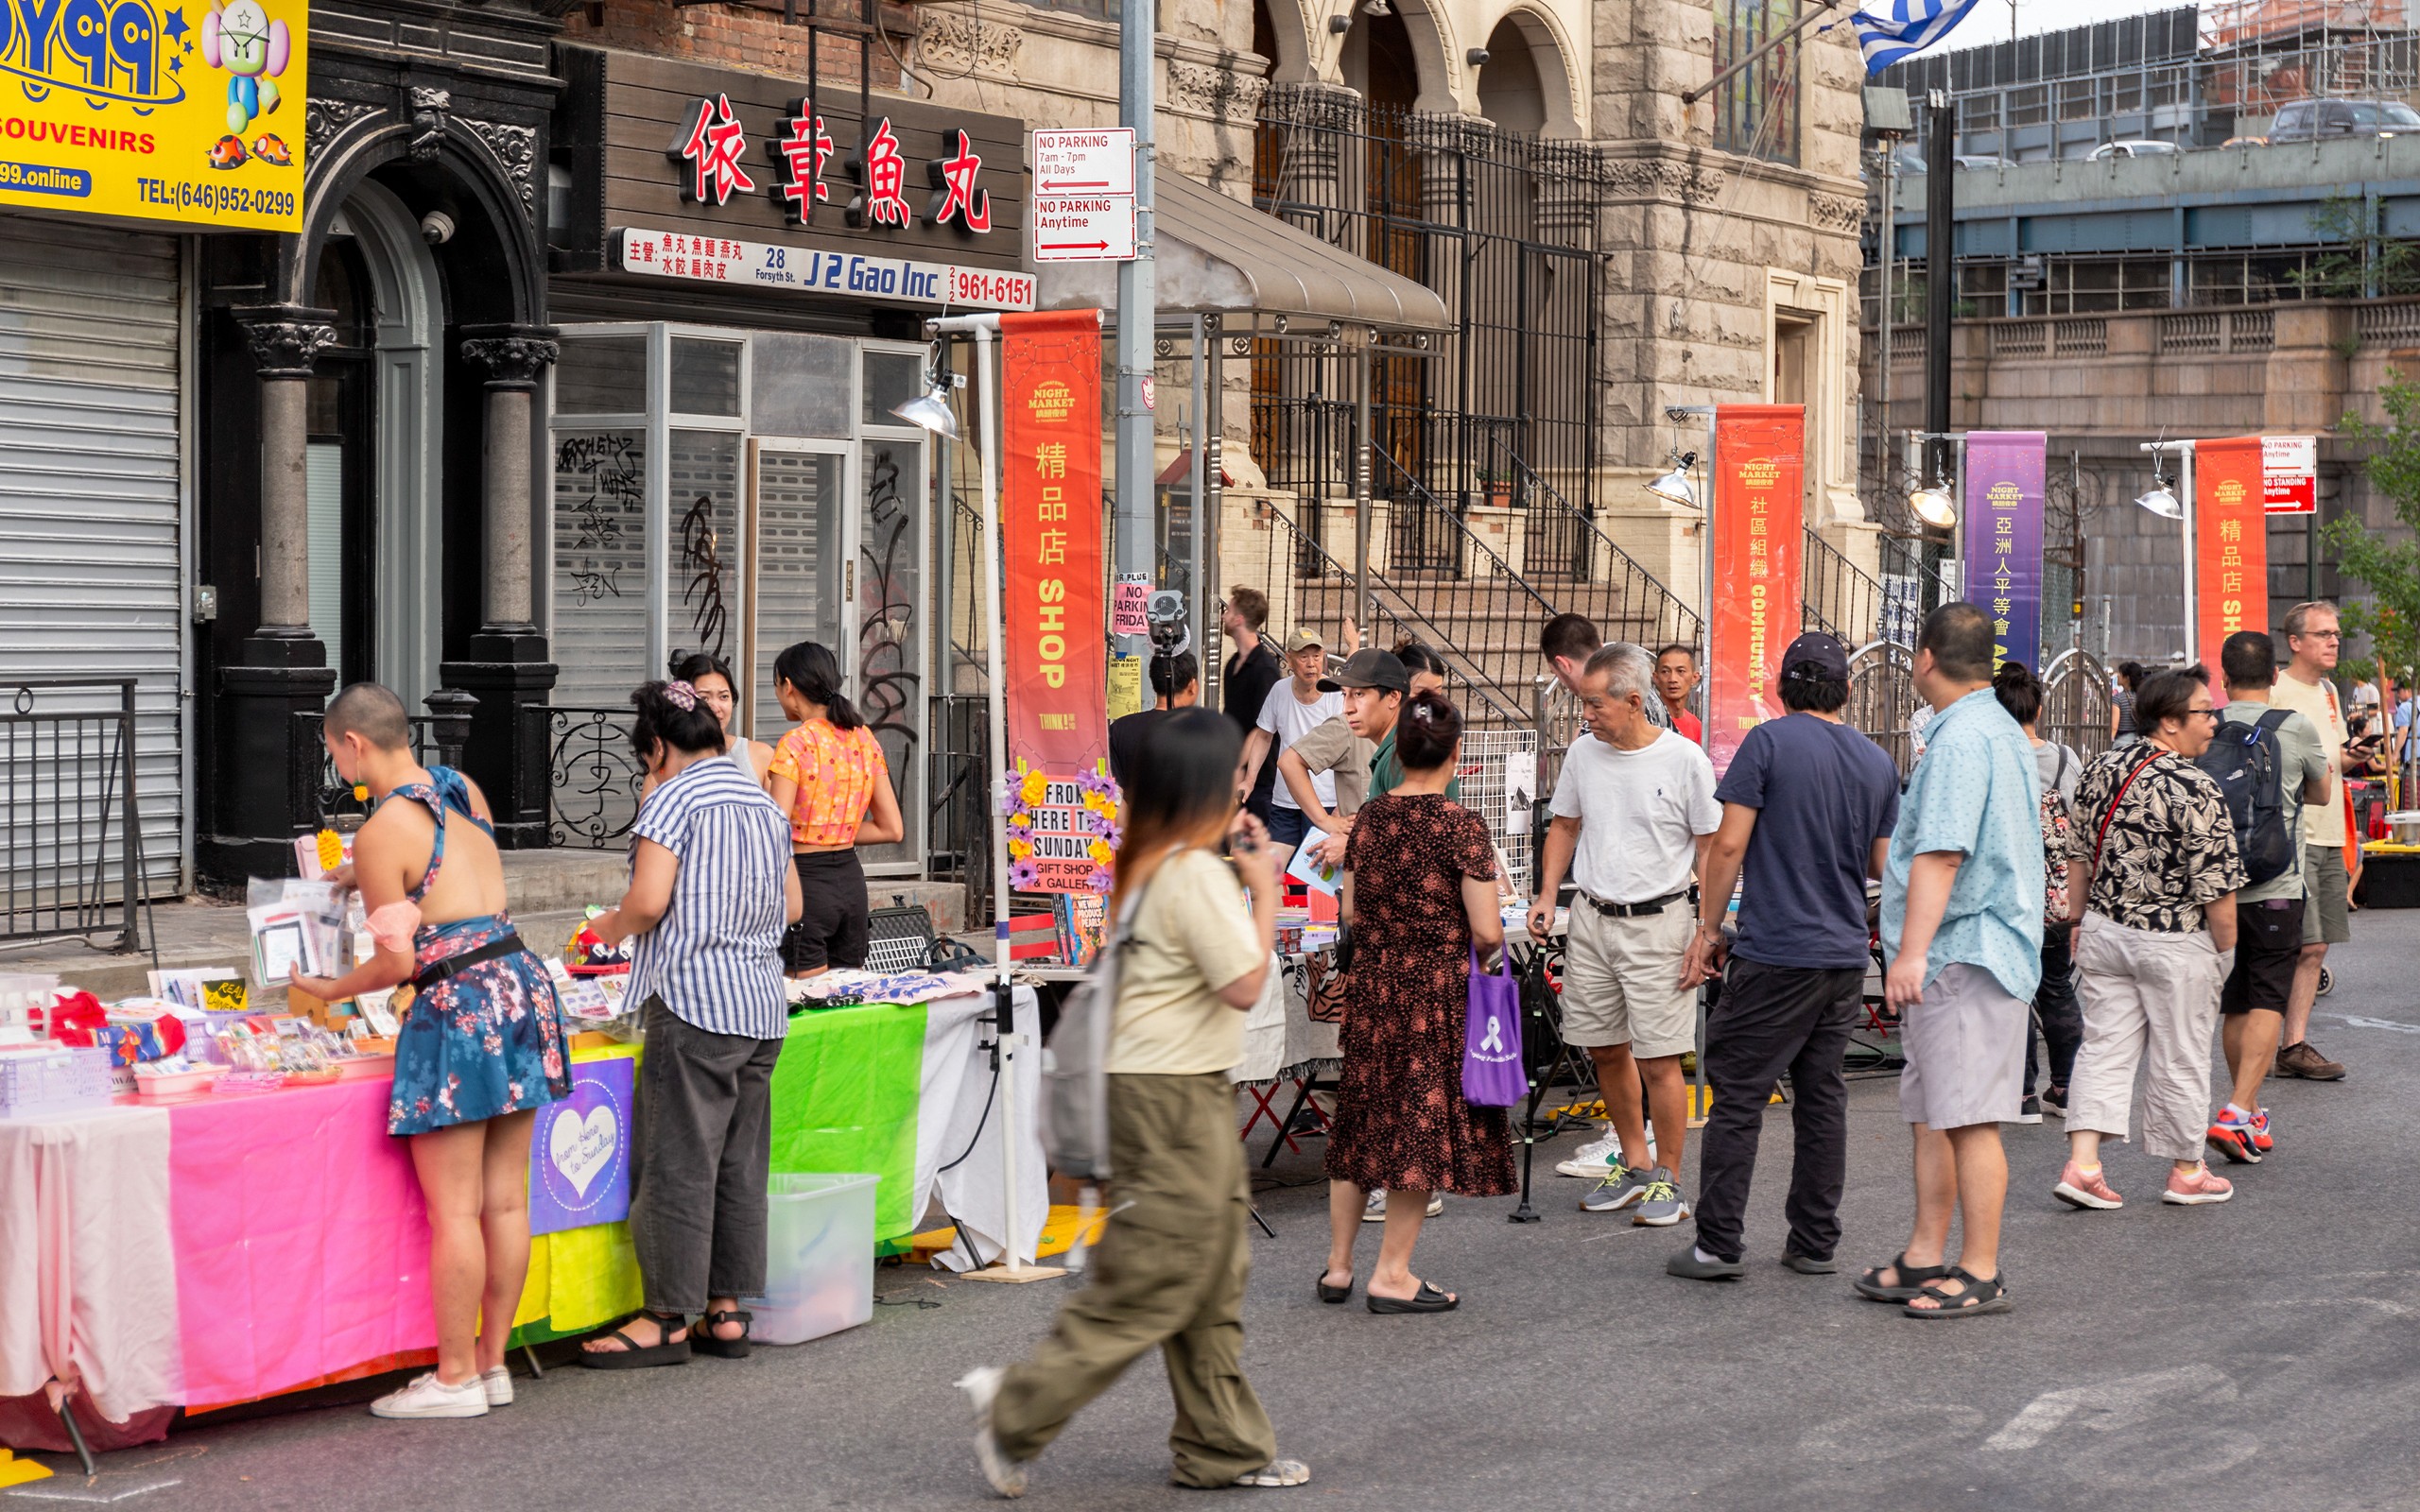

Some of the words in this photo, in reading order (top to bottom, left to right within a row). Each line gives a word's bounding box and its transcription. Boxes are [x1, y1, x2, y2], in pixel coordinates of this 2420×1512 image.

[0, 117, 155, 154] OUVENIRS
[1039, 136, 1055, 148] NO
[1059, 135, 1108, 147] PARKING
[683, 92, 992, 233] 依章魚丸
[1040, 152, 1059, 163] 7am
[1066, 152, 1086, 163] 7pm
[1040, 164, 1051, 174] All
[1054, 164, 1076, 176] Days
[137, 178, 295, 215] TEL:(646)952-0299
[1040, 201, 1056, 213] NO
[1060, 200, 1111, 213] PARKING
[1041, 216, 1089, 231] Anytime
[662, 233, 686, 254] 魚丸
[766, 247, 786, 269] 28
[755, 268, 785, 284] Forsyth
[785, 272, 796, 284] St.
[848, 256, 896, 294] Gao
[901, 263, 939, 299] Inc
[959, 272, 1032, 305] 961-6151
[1028, 398, 1076, 408] MARKET
[1034, 388, 1070, 399] NIGHT
[2263, 488, 2290, 497] Anytime
[2273, 478, 2307, 487] STANDING
[1035, 441, 1067, 565] 精品店
[1750, 497, 1769, 578] 社區組織
[2220, 519, 2242, 593] 精品店
[1127, 573, 1148, 581] PLUG
[1993, 517, 2013, 636] 亞洲人平等會
[1126, 587, 1143, 598] NO
[2222, 599, 2241, 644] SH
[1038, 578, 1065, 689] SHOP
[1749, 584, 1767, 704] COMMUNITY
[1039, 713, 1069, 730] THINK!
[1030, 810, 1068, 831] HERE
[1034, 837, 1092, 859] SUNDAY
[1036, 863, 1061, 874] GIFT
[1063, 864, 1094, 875] SHOP
[1033, 878, 1041, 887] &
[1046, 877, 1095, 890] GALLER
[218, 982, 242, 999] REAL
[556, 1143, 578, 1167] from
[579, 1123, 599, 1144] Here
[570, 1160, 581, 1175] to
[582, 1132, 614, 1165] Sunday
